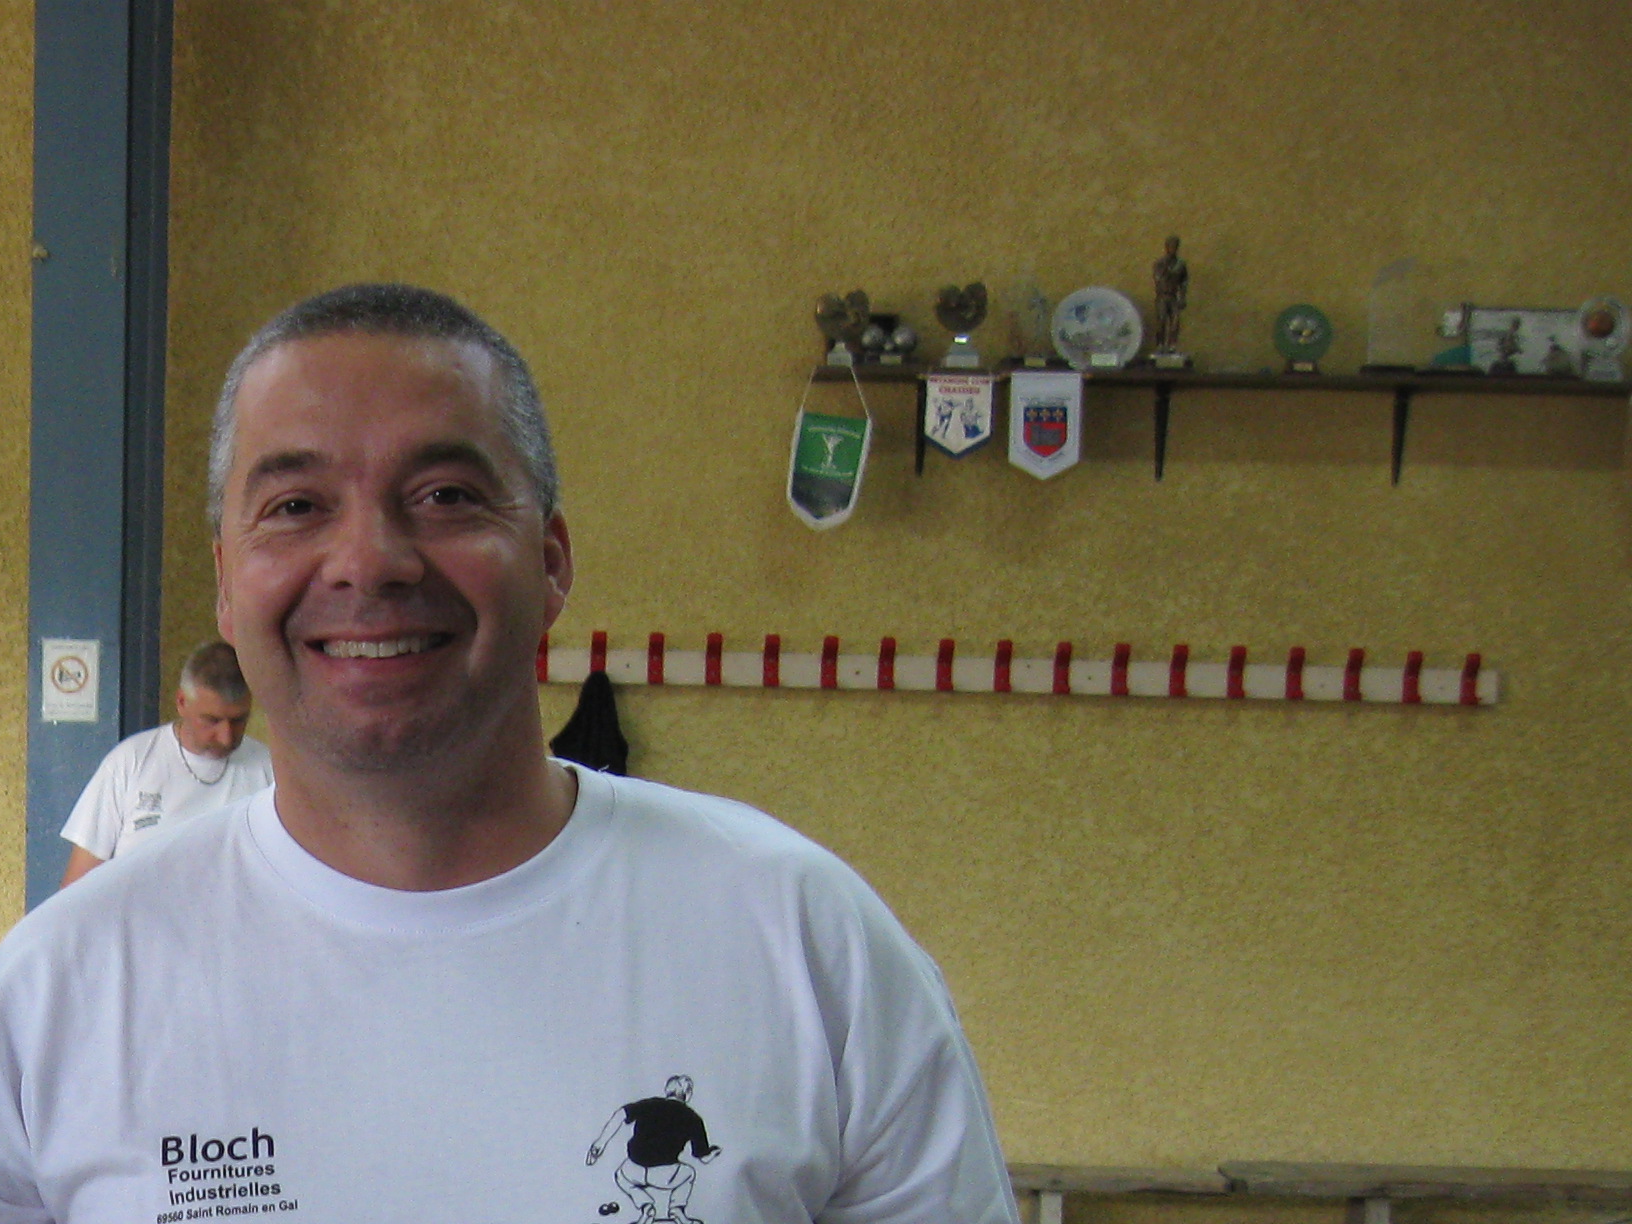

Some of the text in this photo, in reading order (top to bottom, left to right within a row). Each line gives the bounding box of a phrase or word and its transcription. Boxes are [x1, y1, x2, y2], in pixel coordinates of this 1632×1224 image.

[161, 1126, 275, 1167] Bloch
[167, 1163, 276, 1184] Fournitures
[169, 1182, 281, 1206] Industrielles
[156, 1199, 298, 1224] 69560 Saint Romain en Gal
